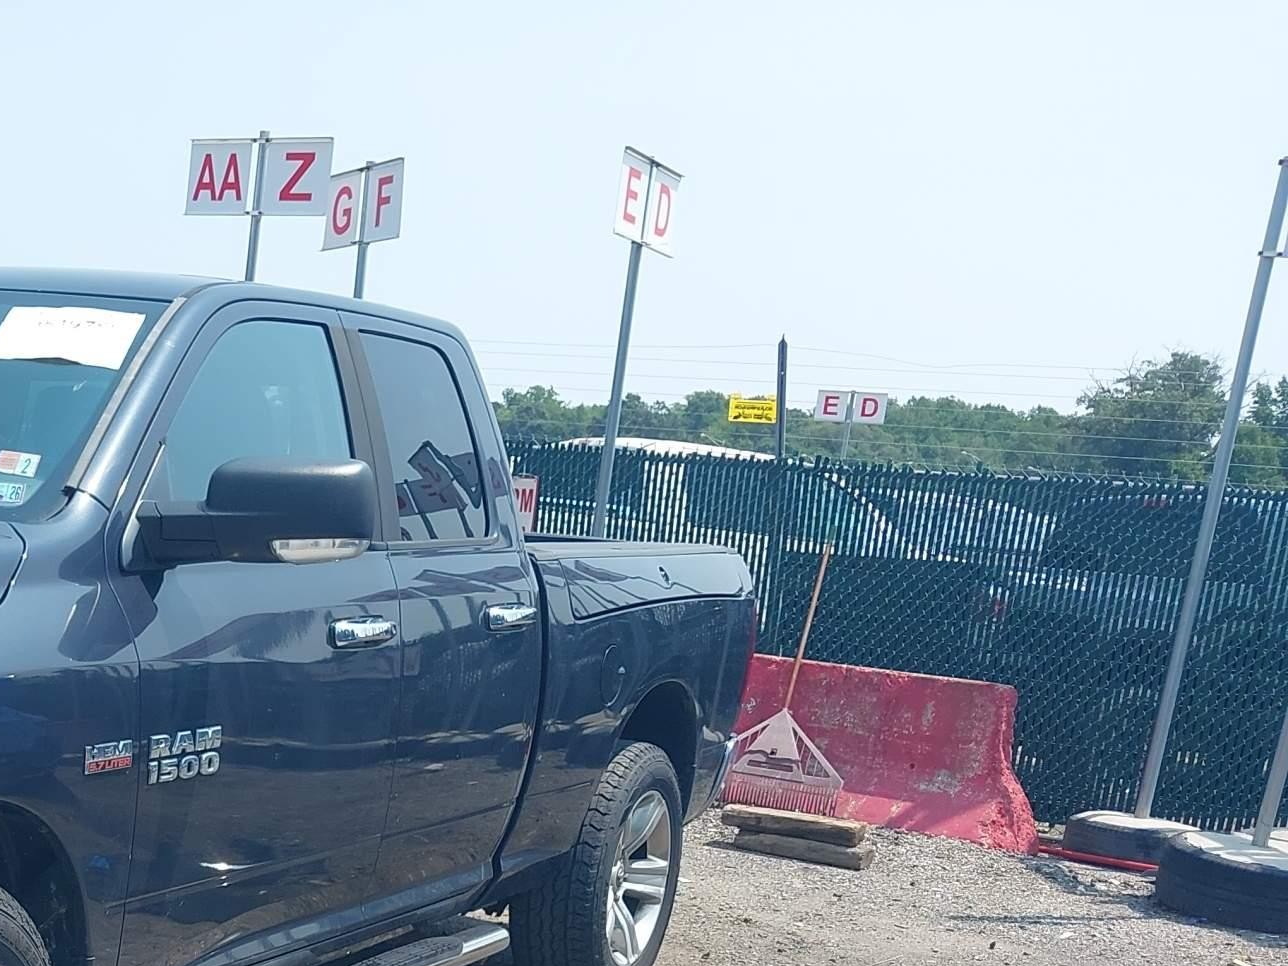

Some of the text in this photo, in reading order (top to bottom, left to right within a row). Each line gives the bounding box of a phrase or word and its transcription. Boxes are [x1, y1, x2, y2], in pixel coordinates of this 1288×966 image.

[192, 152, 316, 202] AA Z
[332, 175, 395, 235] G F
[622, 166, 673, 237] E D
[822, 395, 879, 418] E D
[20, 457, 32, 474] 2
[149, 725, 222, 760] RAM
[147, 751, 220, 785] 1500
